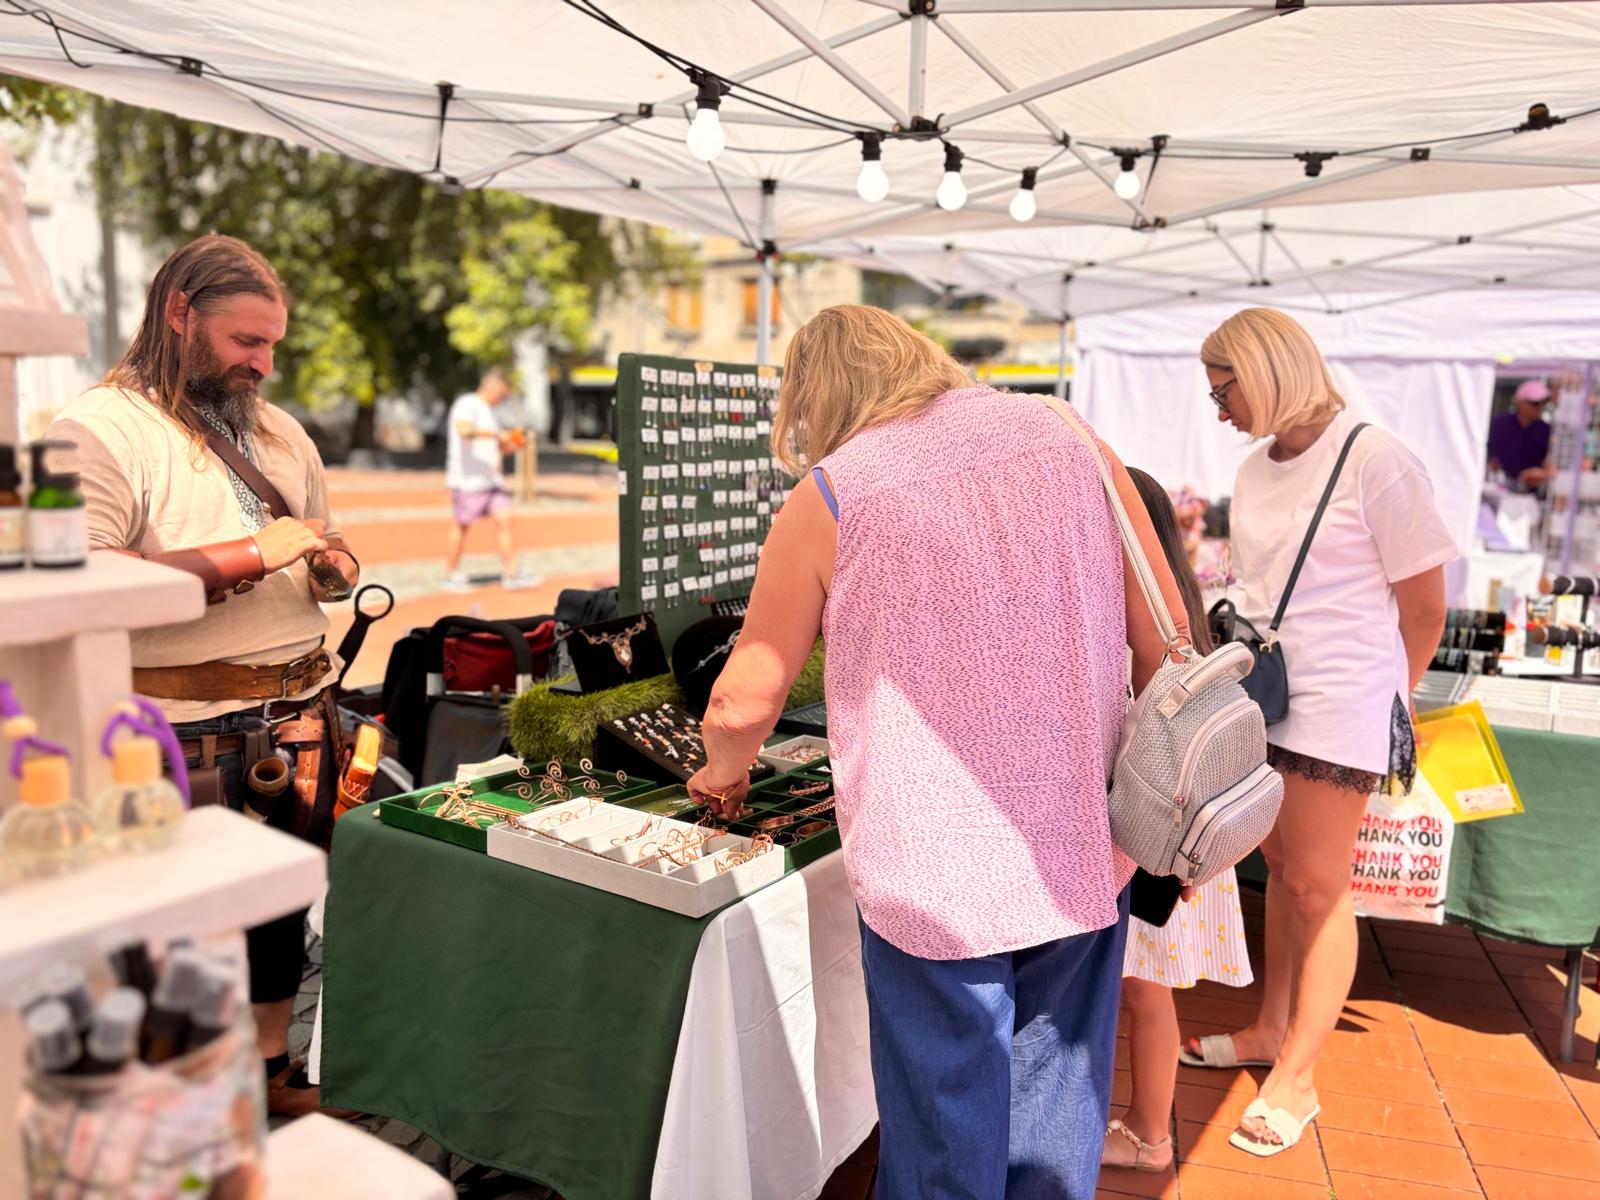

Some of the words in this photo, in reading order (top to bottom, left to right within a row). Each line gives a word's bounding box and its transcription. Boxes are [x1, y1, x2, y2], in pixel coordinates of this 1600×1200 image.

[1362, 812, 1406, 831] HANK
[1410, 816, 1442, 832] YOU
[1357, 827, 1404, 845] HANK
[1408, 831, 1442, 847] YOU
[1353, 849, 1403, 867] HANK
[1410, 854, 1443, 869] YOU
[1352, 862, 1401, 880] HANK
[1409, 869, 1440, 881] YOU
[1351, 881, 1398, 896] HANK
[1405, 886, 1438, 898] YOU
